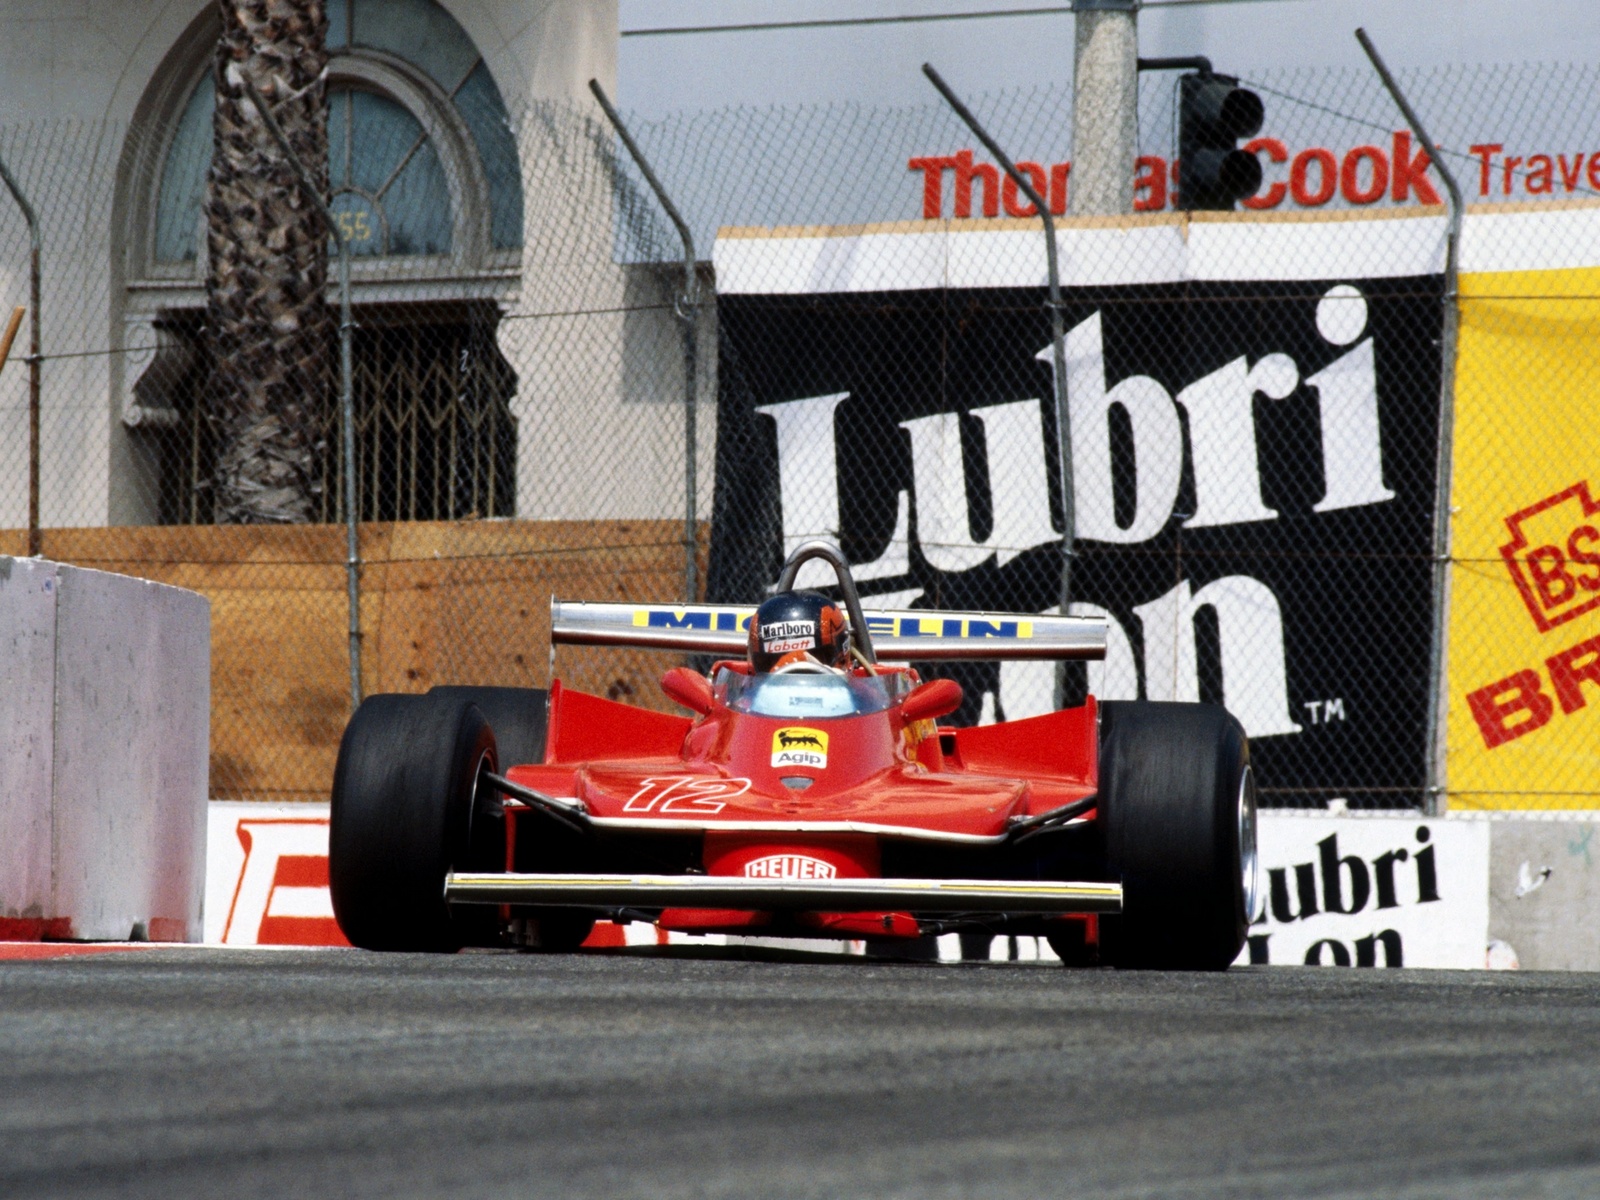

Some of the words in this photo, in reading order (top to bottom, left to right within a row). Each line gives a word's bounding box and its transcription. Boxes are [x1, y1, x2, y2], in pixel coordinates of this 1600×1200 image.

[908, 148, 1180, 219] Thoa
[330, 210, 371, 242] 55
[754, 284, 1395, 592] Lubri
[648, 610, 1018, 638] MIELIN
[763, 622, 813, 640] Marlboro
[768, 639, 811, 653] Labatt
[1304, 698, 1345, 725] TM
[777, 752, 821, 764] Agip
[623, 776, 752, 814] 12
[751, 857, 830, 879] HEUER
[1250, 826, 1442, 926] ubri
